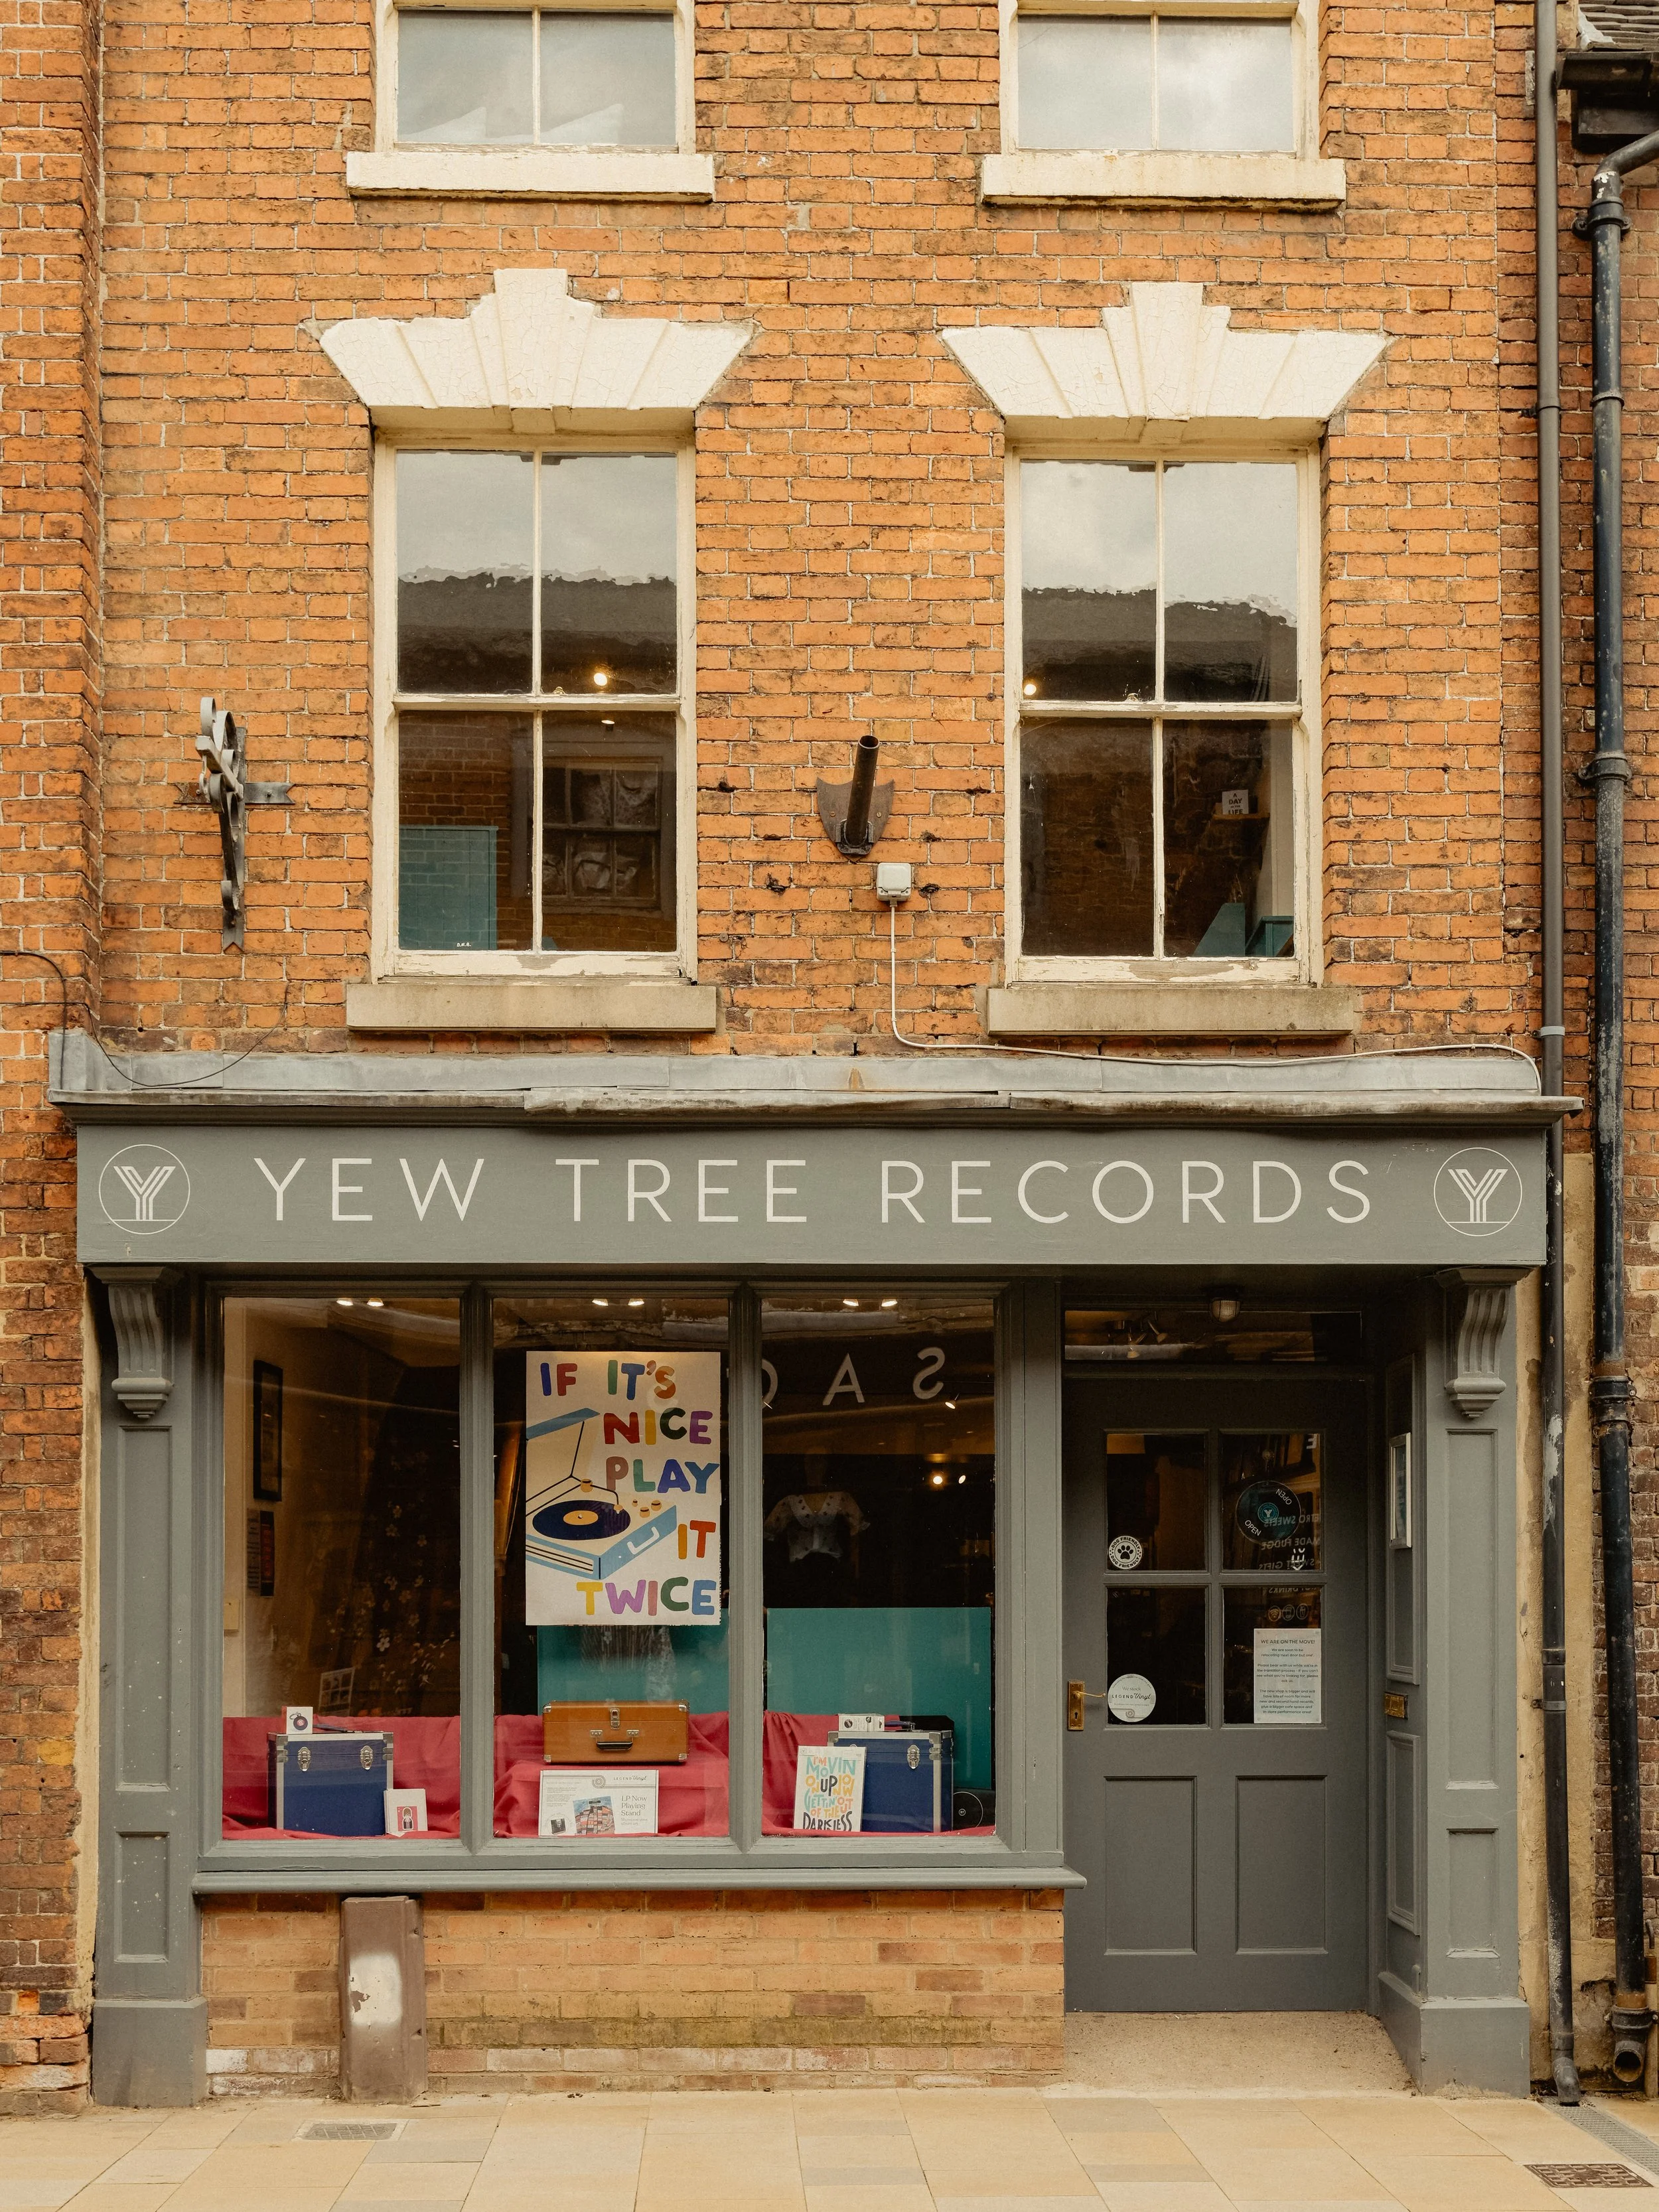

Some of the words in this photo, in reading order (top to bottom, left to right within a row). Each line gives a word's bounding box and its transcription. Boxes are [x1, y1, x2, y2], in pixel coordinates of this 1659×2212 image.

[253, 1157, 485, 1222] YEW
[555, 1158, 808, 1223] TREE
[881, 1160, 1371, 1224] RECORDS
[540, 1363, 577, 1396] IF
[607, 1360, 676, 1400] IT'S
[604, 1407, 713, 1445] NICE
[606, 1456, 720, 1494] PLAY
[1275, 1489, 1292, 1505] OPEN
[678, 1520, 716, 1560] IT
[1244, 1520, 1262, 1536] OPEN
[1120, 1536, 1141, 1550] FRIENDLY
[576, 1576, 715, 1616] TWICE
[814, 1756, 827, 1766] I'M
[820, 1775, 838, 1796] UP
[811, 1808, 822, 1818] OF
[824, 1805, 840, 1818] THE
